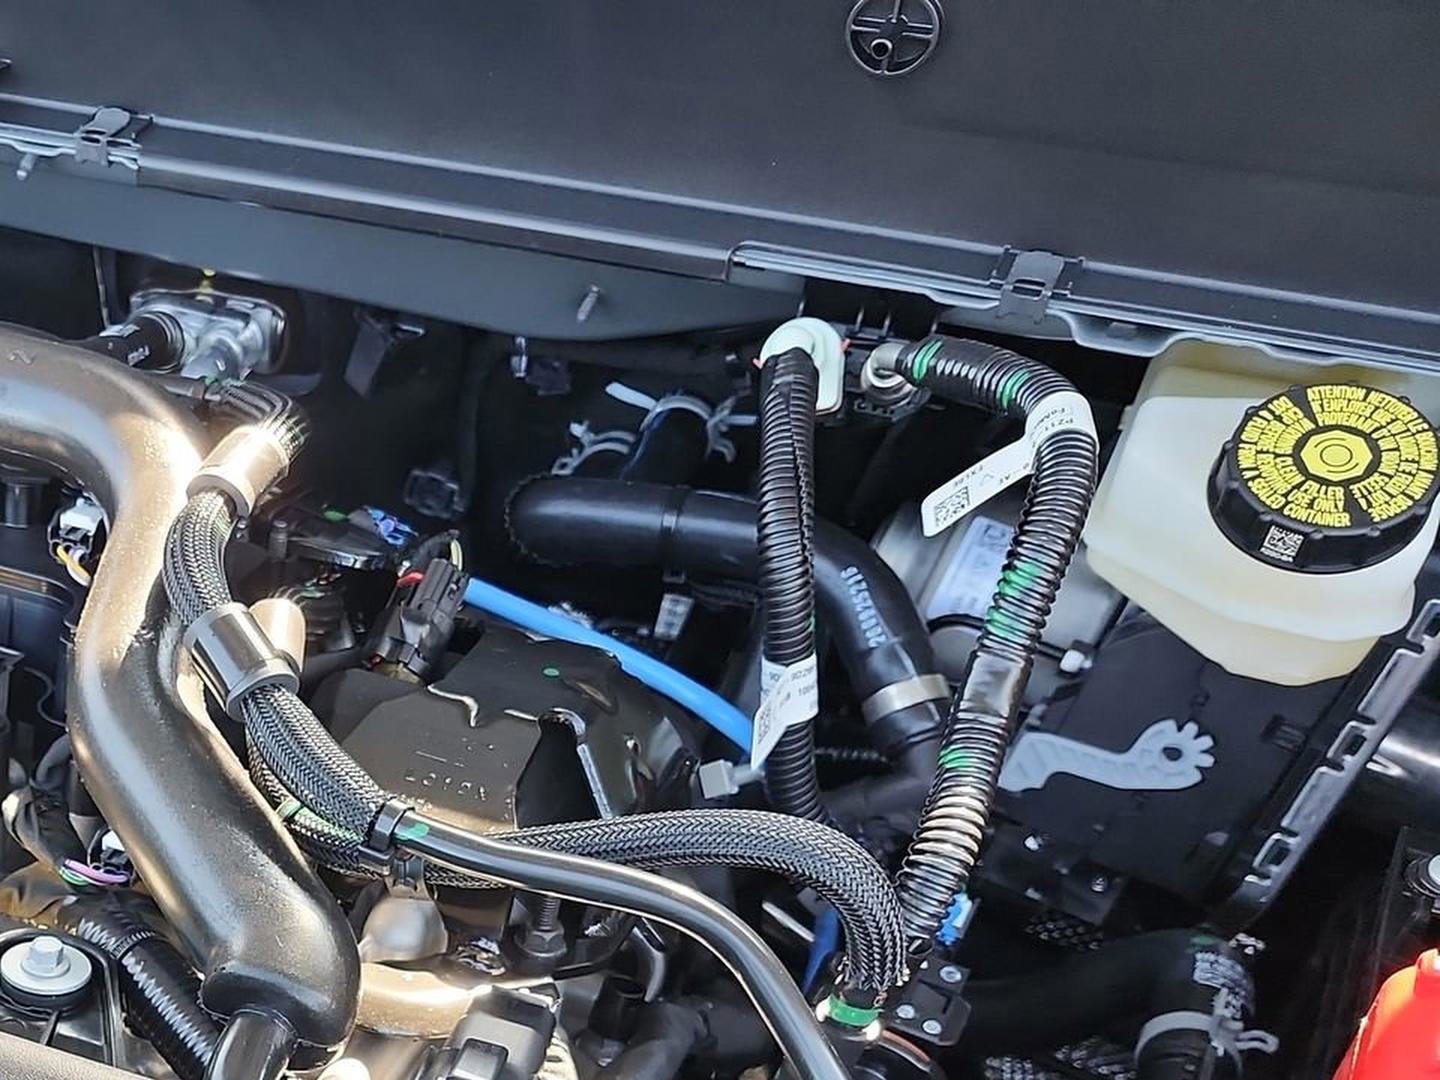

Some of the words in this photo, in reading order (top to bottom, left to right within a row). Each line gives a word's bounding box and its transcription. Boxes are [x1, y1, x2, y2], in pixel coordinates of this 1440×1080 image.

[1306, 385, 1367, 400] ATTENTION
[1267, 396, 1294, 415] DOT
[1366, 390, 1419, 424] NETTOYER
[1280, 406, 1304, 425] CAP
[1241, 416, 1269, 443] FLUID
[1406, 418, 1429, 433] LE
[1241, 470, 1260, 479] A
[1247, 478, 1286, 509] SEALED
[1300, 480, 1344, 499] FILLER
[1404, 470, 1434, 500] AVANT
[1287, 489, 1313, 507] USE
[1313, 498, 1345, 512] ONLY
[1283, 502, 1351, 527] CONTAINER
